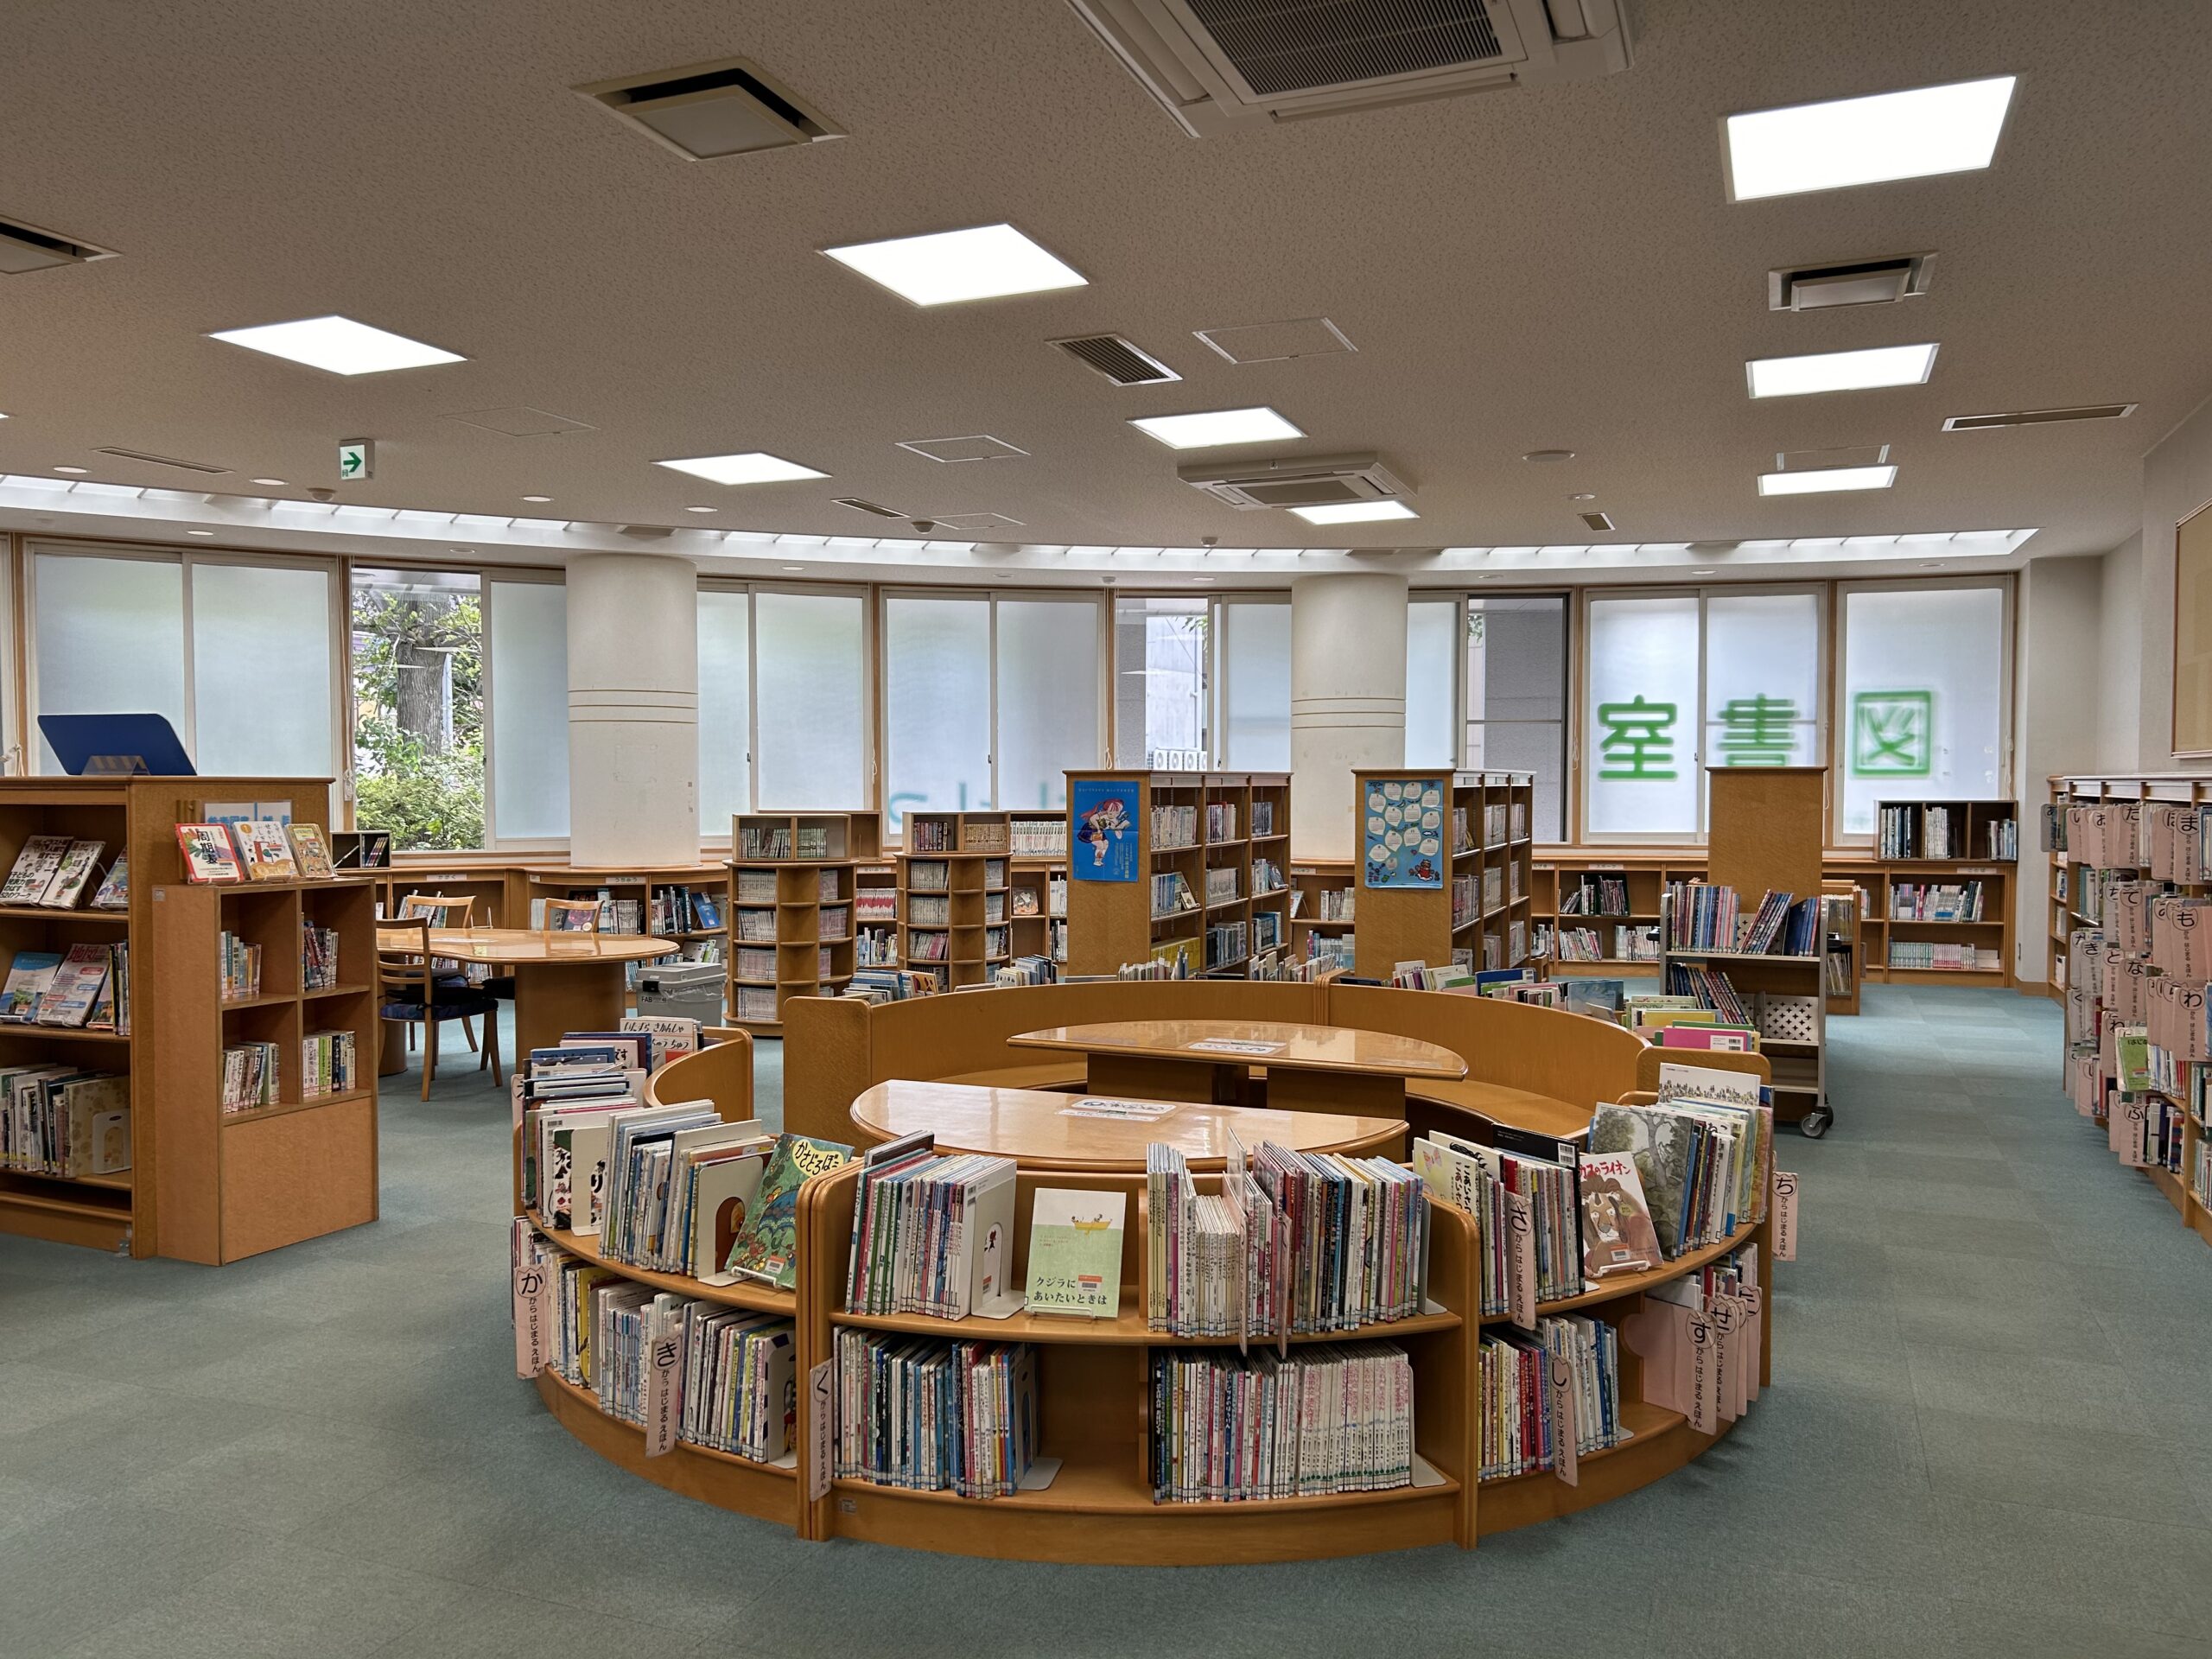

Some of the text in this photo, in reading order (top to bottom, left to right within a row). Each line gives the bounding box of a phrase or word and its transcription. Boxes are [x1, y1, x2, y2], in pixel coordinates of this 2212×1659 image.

[2181, 816, 2198, 831] ま
[2123, 891, 2139, 905] て
[2177, 912, 2195, 927] も
[2084, 943, 2099, 956] き
[2107, 950, 2120, 964] と
[2127, 961, 2144, 975] な
[2183, 992, 2202, 1007] わ
[1775, 1176, 1795, 1196] ち
[1510, 1206, 1528, 1232] さ
[1778, 1197, 1789, 1258] から はじまる えほん
[521, 1273, 543, 1295] か
[1036, 1276, 1077, 1289] クジラに
[1514, 1233, 1525, 1324] から はじまる えほん
[1033, 1291, 1108, 1306] あいたいときは
[1710, 1306, 1732, 1332] せ
[529, 1298, 542, 1373] から はじまる えほん
[1690, 1321, 1711, 1344] す
[657, 1342, 677, 1367] き
[817, 1370, 829, 1395] く
[1551, 1361, 1567, 1387] し
[1694, 1347, 1704, 1428] から はじまる えほん
[660, 1389, 670, 1422] はじまる
[658, 1425, 668, 1452] えほん
[1555, 1389, 1567, 1478] から はじまる えほん
